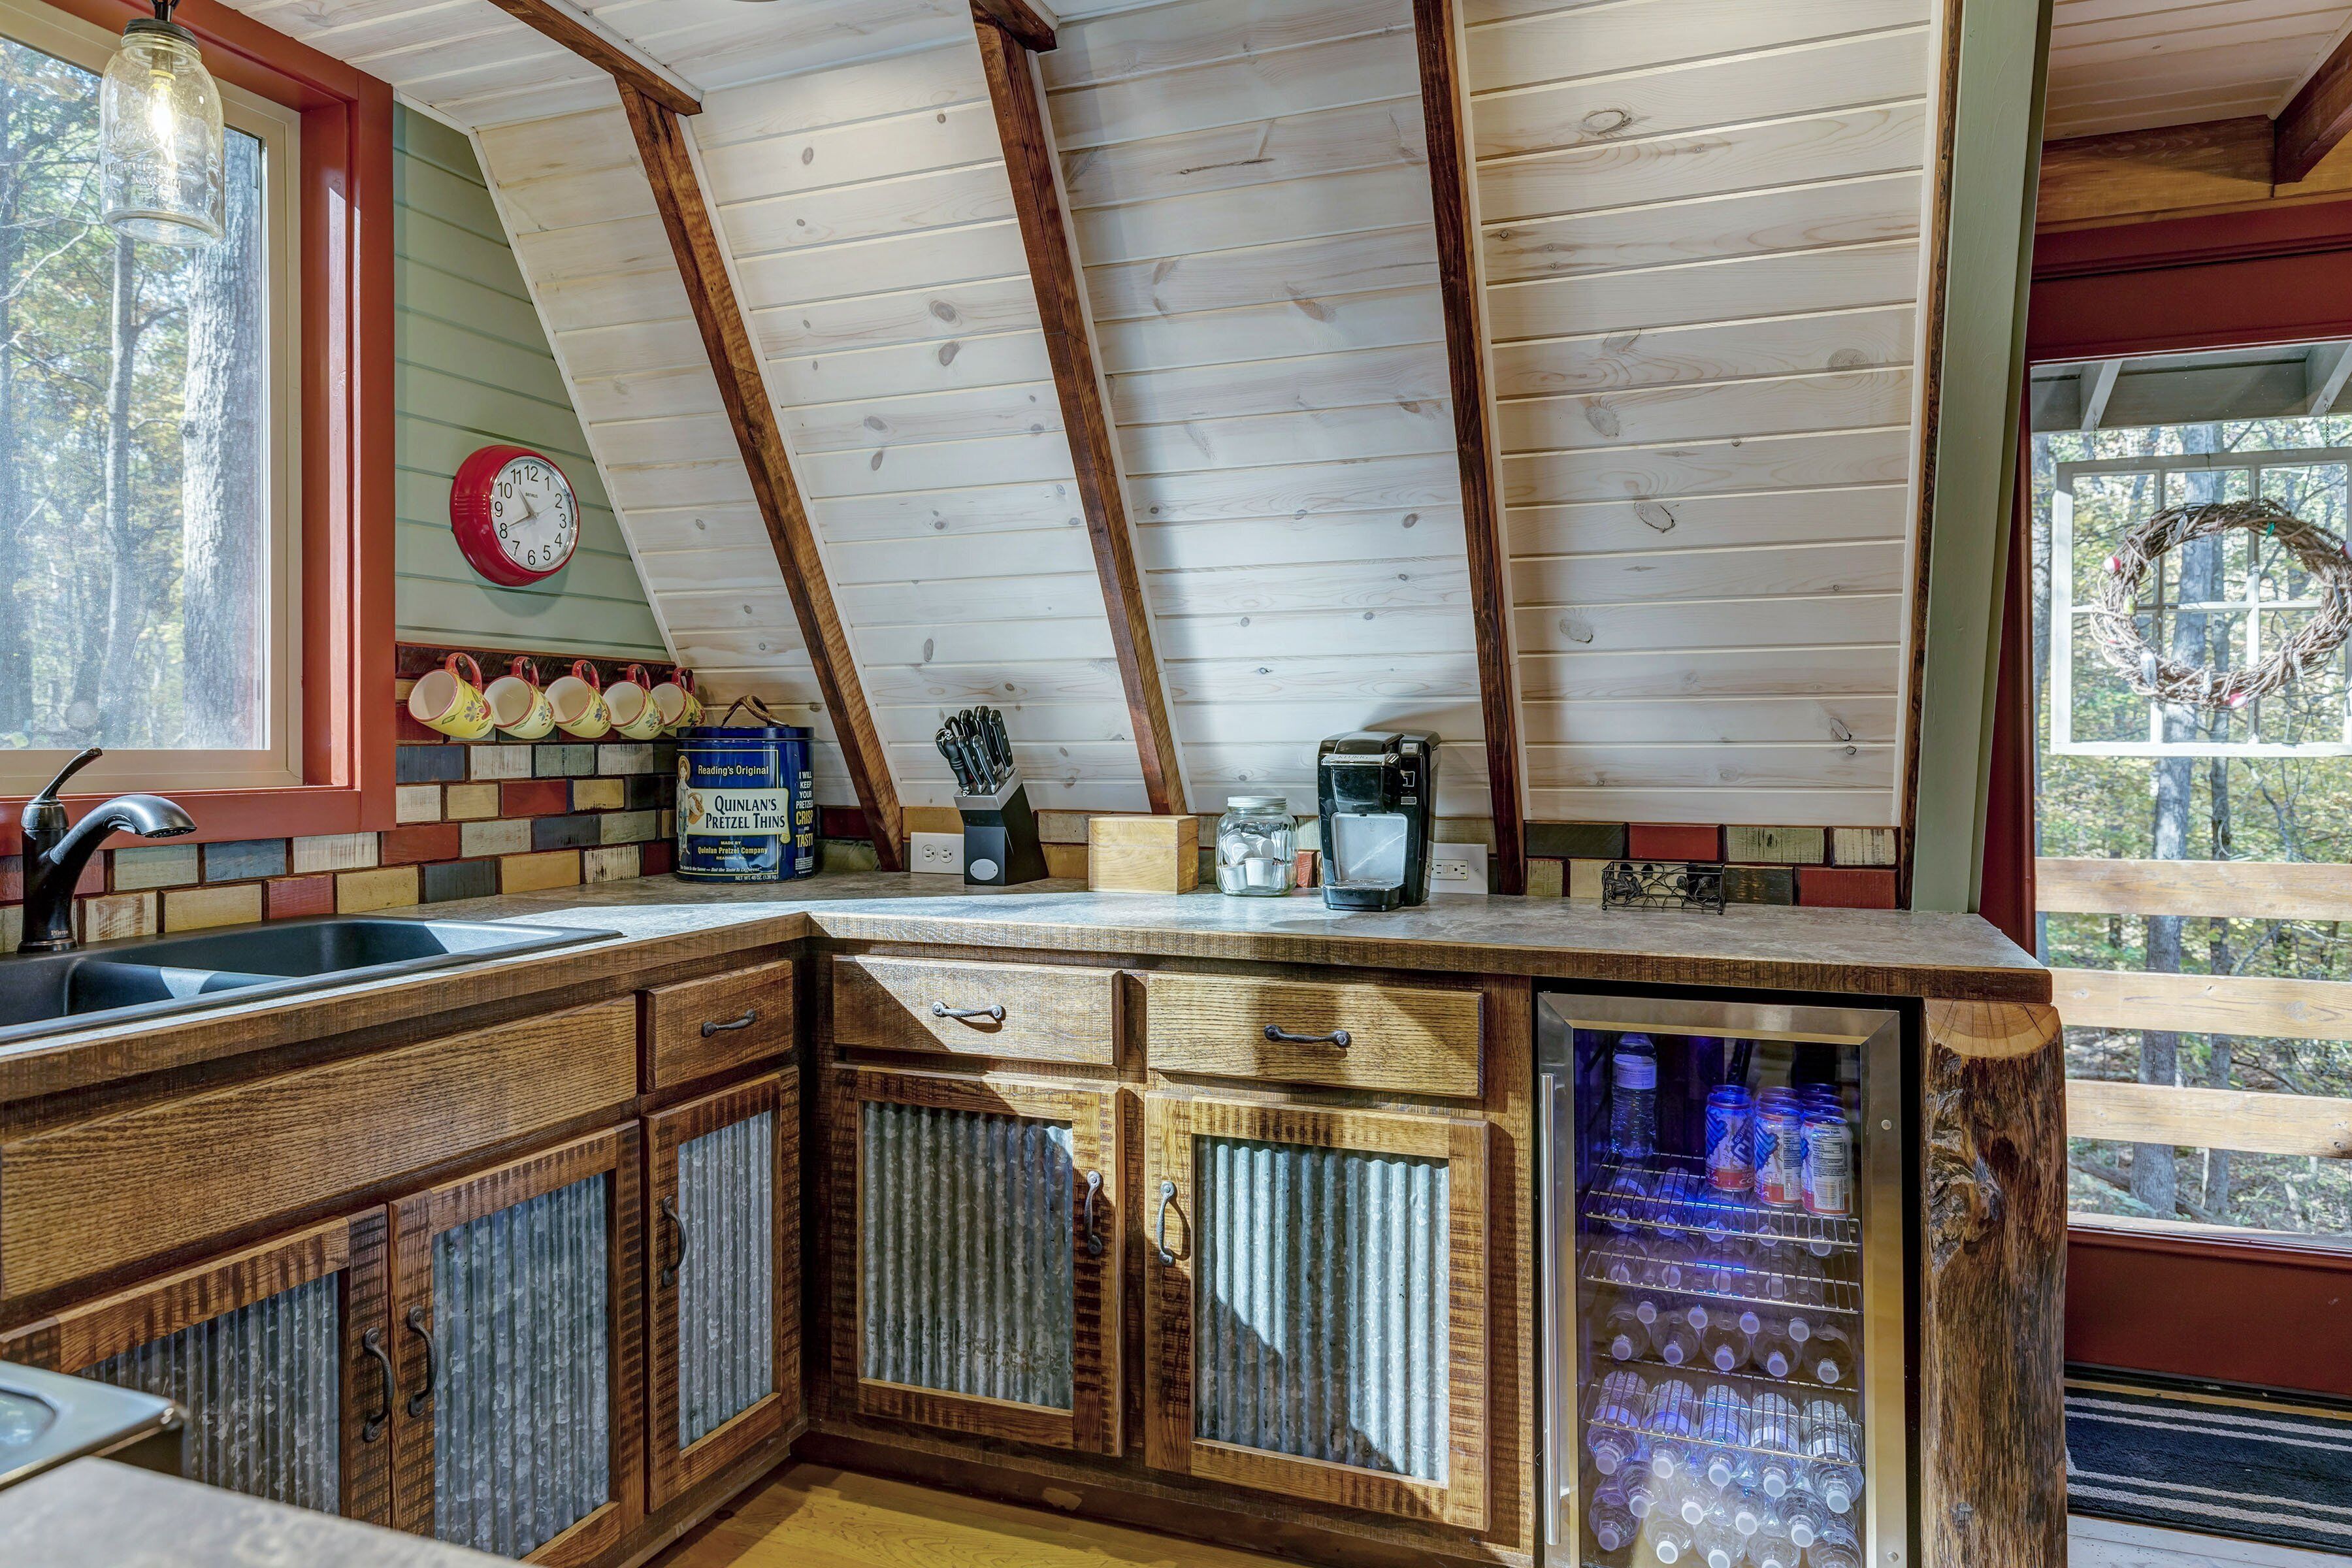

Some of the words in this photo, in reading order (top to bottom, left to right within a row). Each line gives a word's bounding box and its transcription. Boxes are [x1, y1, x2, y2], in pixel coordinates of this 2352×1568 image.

[510, 468, 521, 485] 11
[524, 465, 538, 482] 12
[497, 482, 512, 498] 10
[544, 476, 549, 491] 1
[495, 501, 503, 517] 9
[555, 493, 563, 509] 2
[559, 513, 566, 529] 3
[499, 523, 508, 538] 8
[554, 532, 563, 547] 4
[512, 540, 520, 556] 7
[543, 545, 551, 561] 5
[528, 549, 536, 565] 6
[698, 765, 734, 776] Reading's
[736, 765, 768, 776] Original
[715, 795, 777, 815] QUINLAN'S
[706, 813, 750, 828] PRETZEL
[753, 813, 785, 828] THINS
[796, 809, 813, 825] CRISP
[796, 832, 813, 848] TASTY
[1754, 1186, 1770, 1198] OLA
